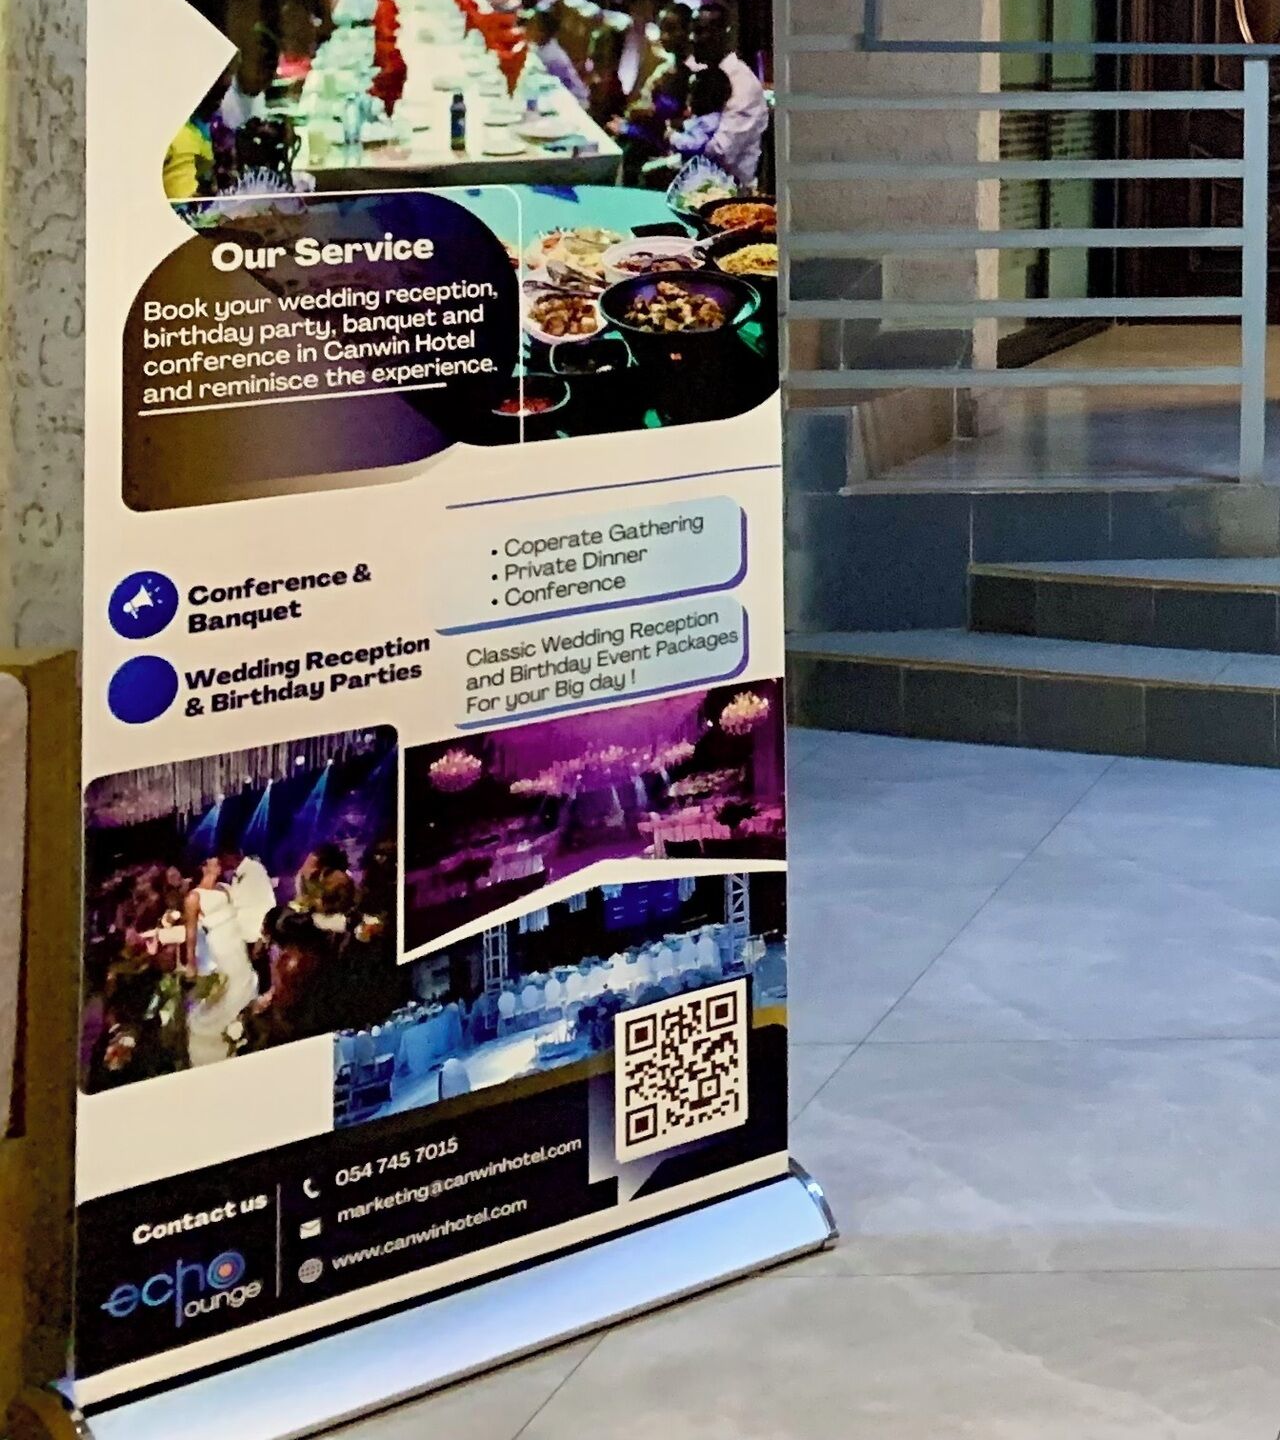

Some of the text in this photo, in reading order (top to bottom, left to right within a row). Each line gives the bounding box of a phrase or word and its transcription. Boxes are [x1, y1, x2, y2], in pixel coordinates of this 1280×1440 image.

[212, 232, 434, 271] Our Service
[144, 280, 498, 321] Book your wedding reception,
[144, 304, 484, 349] birthday party, banquet and
[143, 330, 475, 376] conference in Canwin Hotel
[143, 356, 498, 404] and reminisce the experience.
[505, 516, 704, 558] Coperate Gathering
[188, 563, 371, 606] Conference &
[505, 547, 647, 581] Private Dinner
[505, 575, 626, 606] Conference
[188, 600, 302, 633] Banquet
[466, 610, 719, 667] Classic Wedding Reception
[185, 637, 430, 690] Wedding Reception
[466, 630, 738, 691] and Birthday Event Packages
[185, 663, 422, 717] & Birthday Parties
[466, 695, 500, 714] For
[506, 687, 550, 711] your
[555, 677, 584, 698] Big
[335, 1136, 459, 1186] 054 745 7015
[337, 1138, 582, 1223] marketing@canwinhotel.com
[132, 1194, 268, 1245] Contact us
[331, 1198, 528, 1270] www.canwinhotel.com
[100, 1251, 246, 1324] echo
